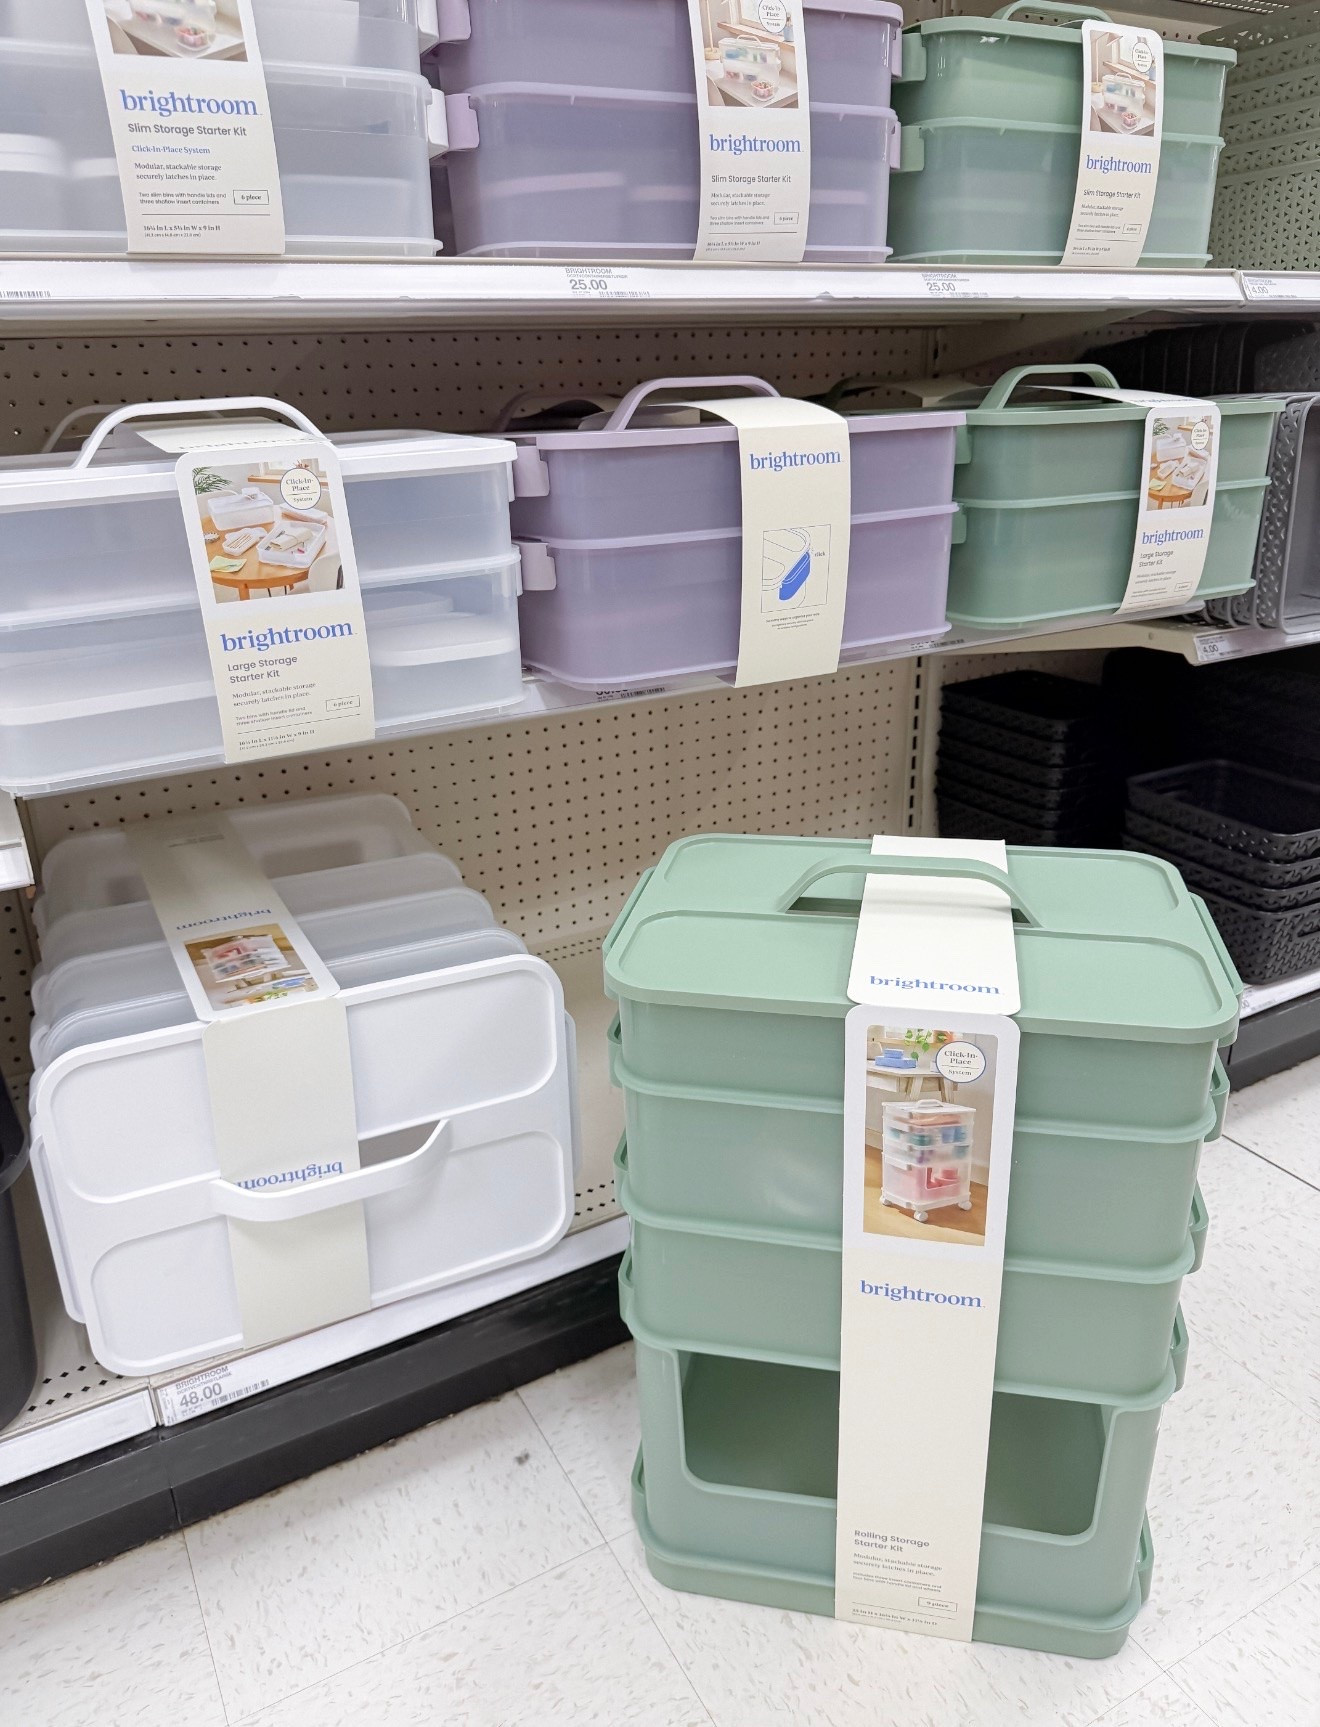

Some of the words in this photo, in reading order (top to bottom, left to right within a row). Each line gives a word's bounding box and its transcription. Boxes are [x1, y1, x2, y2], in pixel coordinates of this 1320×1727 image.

[119, 89, 260, 117] brightroom
[127, 123, 151, 134] Slim
[153, 124, 195, 137] Storage
[196, 126, 231, 136] Starter
[233, 127, 247, 137] Kit
[131, 144, 183, 155] Click-In-Place
[183, 145, 211, 156] System
[709, 133, 801, 155] brightroom
[134, 162, 166, 171] Modular,
[165, 163, 197, 171] stackable
[197, 164, 222, 173] storage
[1086, 154, 1152, 175] brightroom
[136, 172, 164, 181] securely
[165, 173, 189, 181] latches
[711, 174, 727, 183] Slim
[728, 175, 757, 185] Storage
[756, 175, 781, 183] Starter
[782, 175, 791, 183] Kit
[569, 278, 608, 291] 25.00
[926, 281, 956, 292] 25.00
[750, 451, 841, 472] brightroom
[1141, 528, 1204, 546] brightroom
[220, 622, 353, 651] brightroom
[1203, 644, 1218, 654] 4.00
[227, 660, 257, 673] Large
[258, 655, 298, 668] Storage
[229, 670, 265, 684] Starter
[266, 668, 280, 680] Kit
[176, 908, 273, 931] brightroom
[869, 975, 1001, 995] brightroom
[943, 1049, 979, 1059] Click-In-
[949, 1057, 972, 1066] Place
[237, 1161, 344, 1190] brightroom
[860, 1280, 982, 1308] brightroom
[175, 1365, 230, 1391] BRIGHTROOM
[179, 1382, 223, 1408] 48.00
[853, 1538, 887, 1550] Starter
[890, 1544, 904, 1552] Kit
[854, 1529, 888, 1543] Rolling
[889, 1535, 930, 1548] Storage
